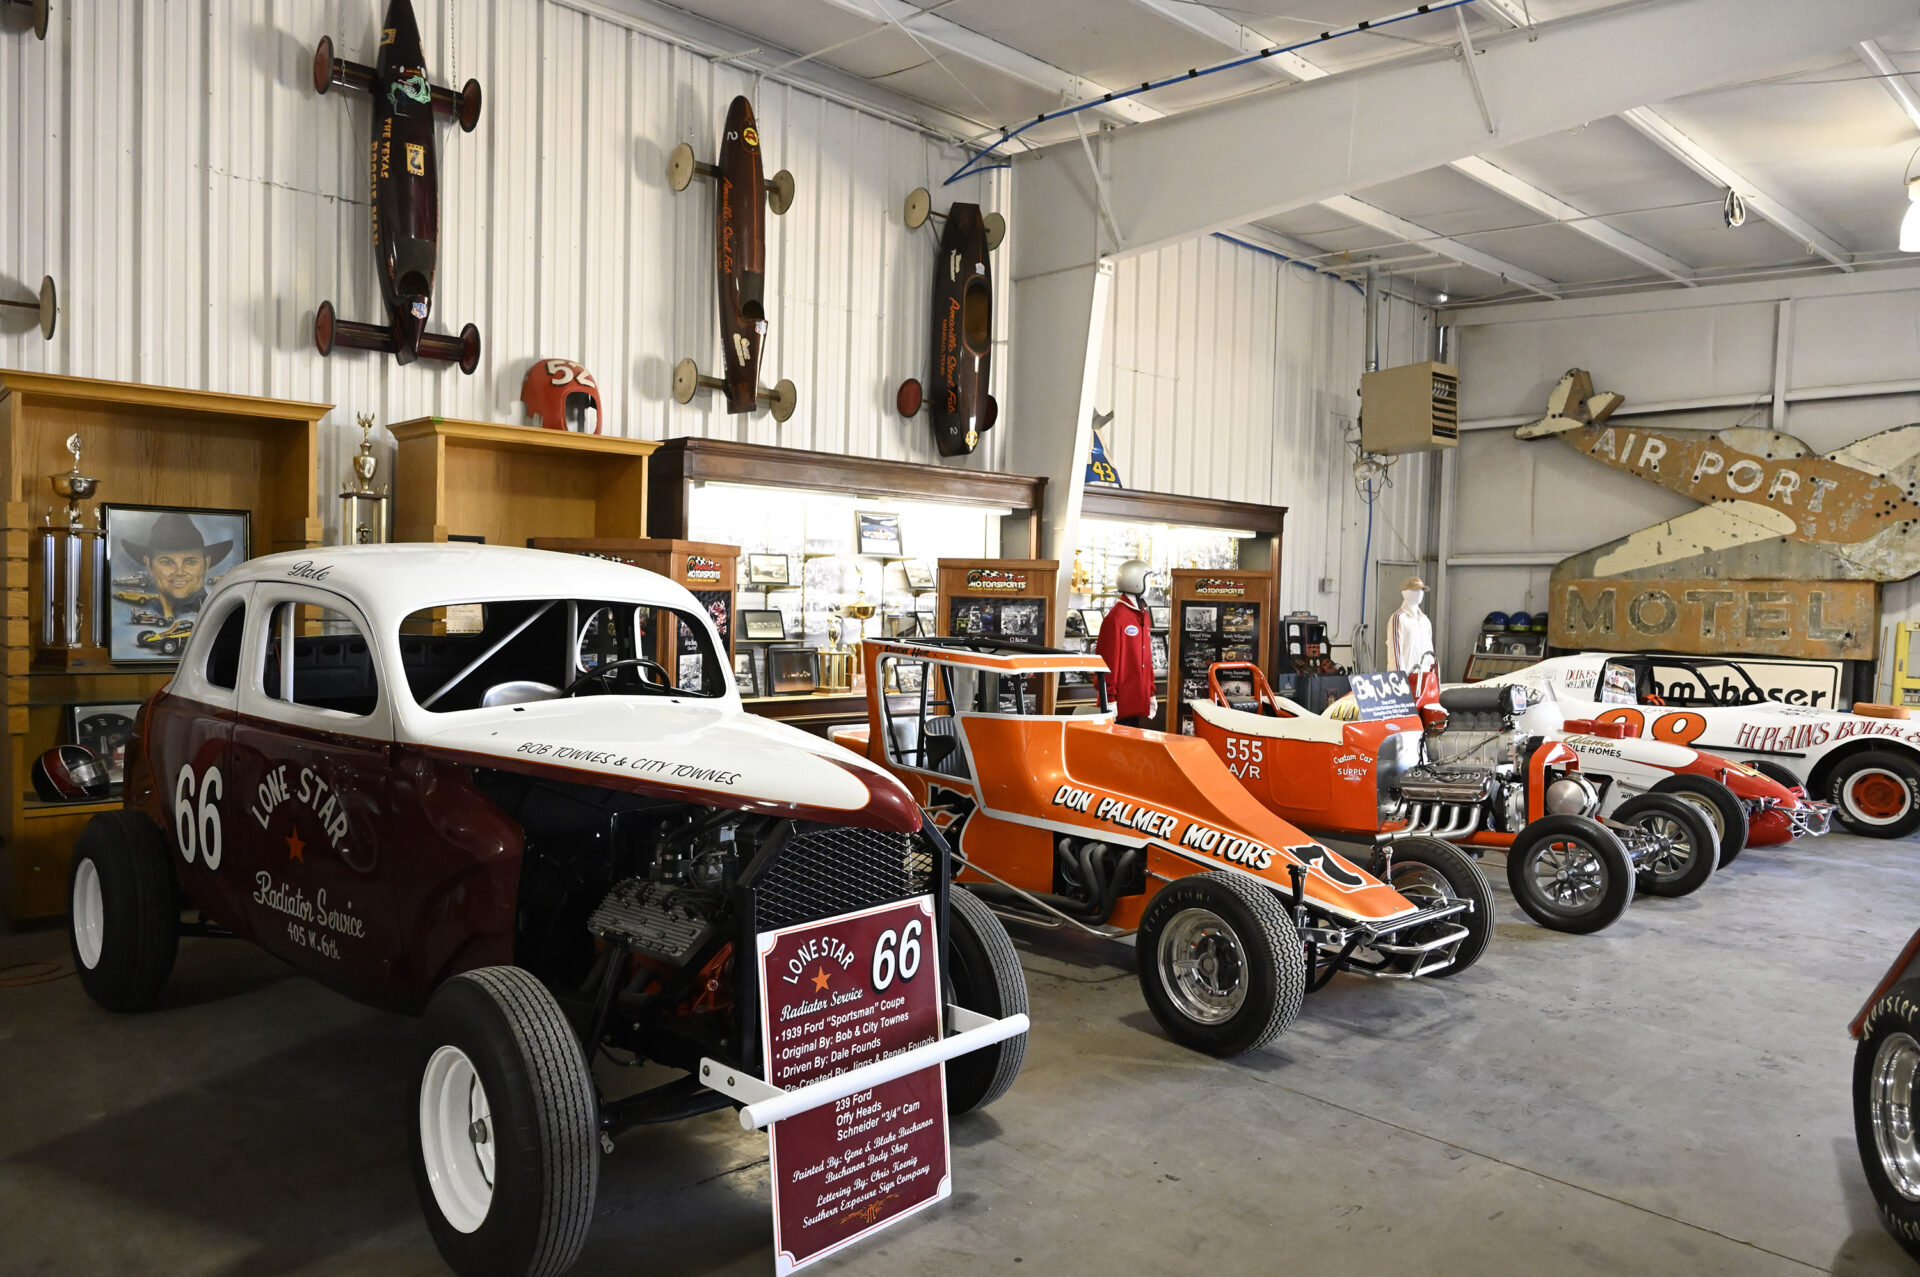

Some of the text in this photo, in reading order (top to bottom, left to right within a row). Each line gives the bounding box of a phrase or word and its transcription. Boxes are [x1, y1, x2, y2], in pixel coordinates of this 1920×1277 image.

[380, 117, 392, 179] THE TEXAS
[722, 177, 734, 222] Amarillo
[948, 296, 961, 353] Amarillo
[547, 360, 596, 388] 52
[946, 355, 957, 388] Steel
[1092, 461, 1116, 482] 43
[1591, 428, 1839, 513] AIR PORT
[287, 560, 334, 581] Dale
[687, 570, 721, 579] MOTORSPORTS
[968, 581, 1027, 589] MOTORSPORTS
[1195, 587, 1246, 595] MOTORSPORTS
[1564, 584, 1855, 641] MOTEL
[1226, 737, 1263, 763] 555
[1588, 747, 1622, 758] HOMES
[1734, 722, 1831, 752] HI-PLAINS
[1831, 720, 1904, 742] BOILER
[517, 742, 742, 785] BOB TOWNES & CITY TOWNES
[1229, 762, 1261, 780] A/R
[1337, 768, 1368, 776] SUPPLY
[1359, 753, 1374, 764] Car
[175, 763, 223, 871] 66
[251, 764, 348, 849] LONE STAR
[1052, 784, 1277, 870] DON PALMER MOTORS
[253, 870, 366, 938] Radiator Service
[287, 921, 306, 946] 405
[782, 936, 855, 984] LONE STAR
[870, 918, 923, 993] 66
[779, 987, 864, 1022] Radiator Service
[781, 1026, 802, 1042] 1939
[803, 1017, 825, 1035] Ford
[880, 996, 905, 1010] Coupe
[782, 1012, 909, 1060] Original By: Bob & City Townes
[783, 1037, 881, 1078] Driven By: Dale Founds
[835, 1089, 872, 1113] 239 Ford
[836, 1101, 882, 1127] Offy Heads
[837, 1117, 879, 1141] Schneider
[902, 1101, 920, 1115] Cam
[792, 1160, 825, 1183] Painted
[826, 1156, 843, 1170] By:
[844, 1147, 863, 1163] Gene
[864, 1141, 872, 1153] &
[873, 1131, 897, 1149] Blake
[867, 1150, 889, 1166] Body
[890, 1142, 909, 1156] Shop
[802, 1163, 930, 1228] Southern Exposure Sign Company
[816, 1156, 918, 1207] Lettering By: Chris Koenig
